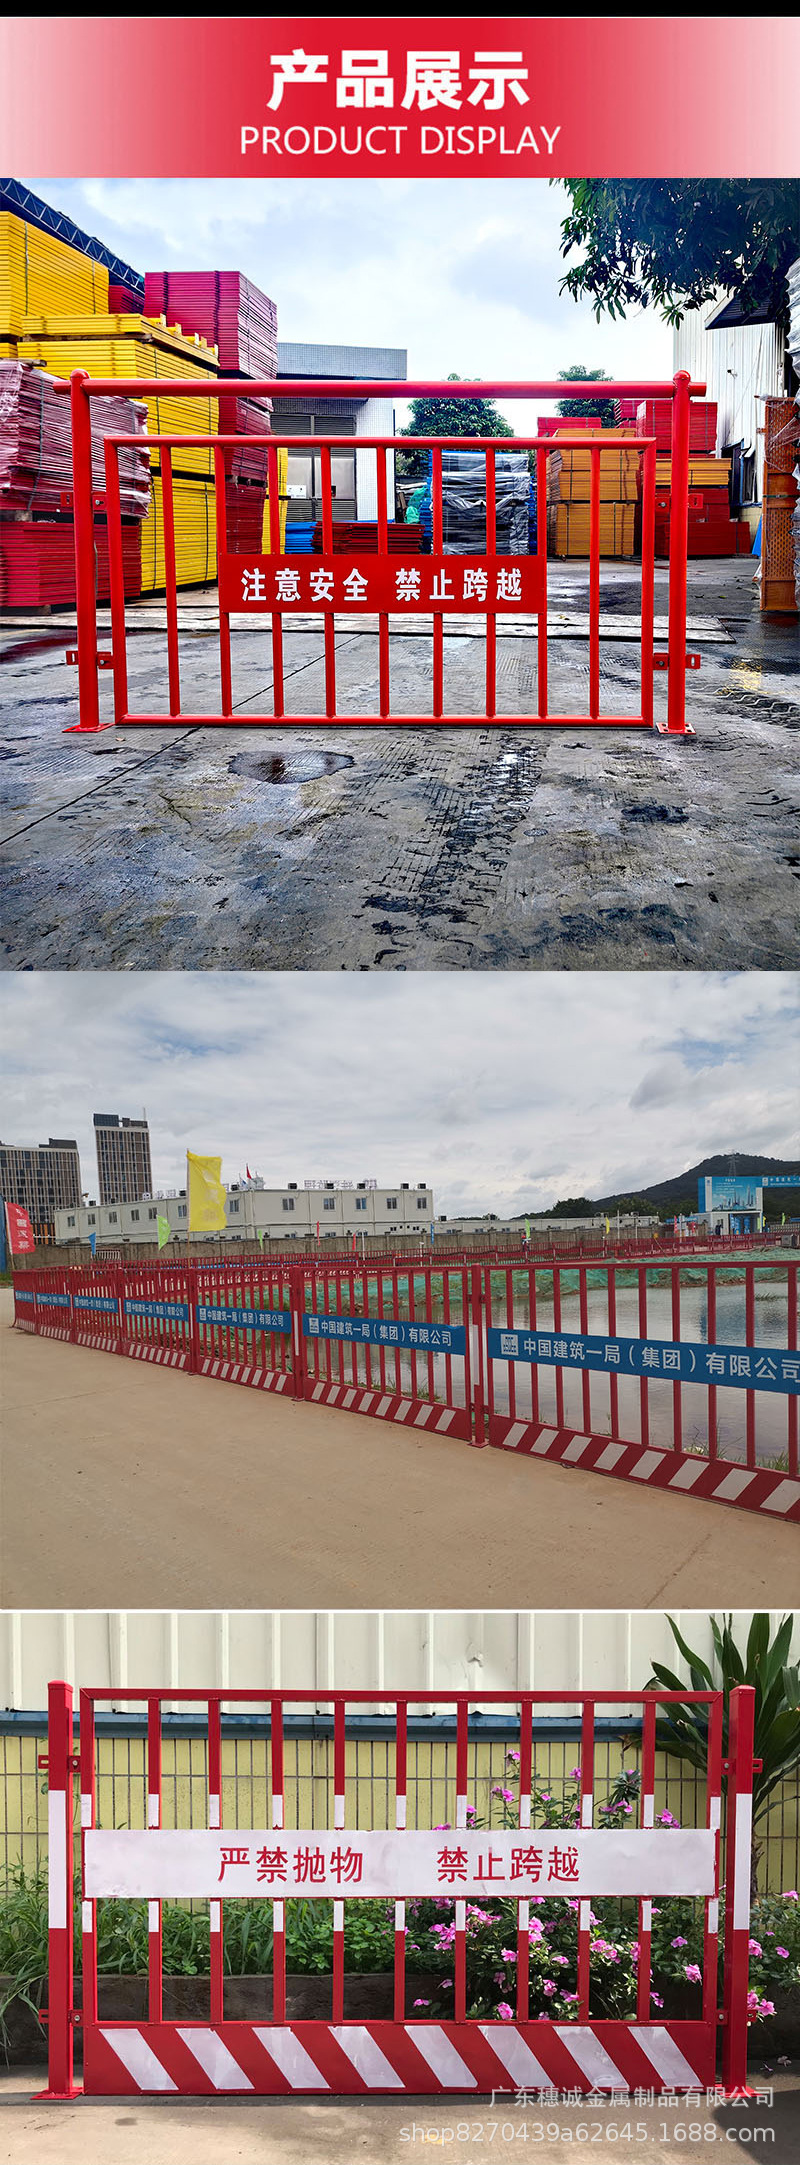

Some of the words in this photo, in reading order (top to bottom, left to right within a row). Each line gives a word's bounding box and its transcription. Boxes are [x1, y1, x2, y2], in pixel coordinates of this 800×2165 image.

[240, 567, 369, 602] 注意安全
[395, 567, 523, 602] 禁止跨越
[217, 1845, 364, 1883] 严禁抛物
[436, 1845, 580, 1883] 禁止跨越
